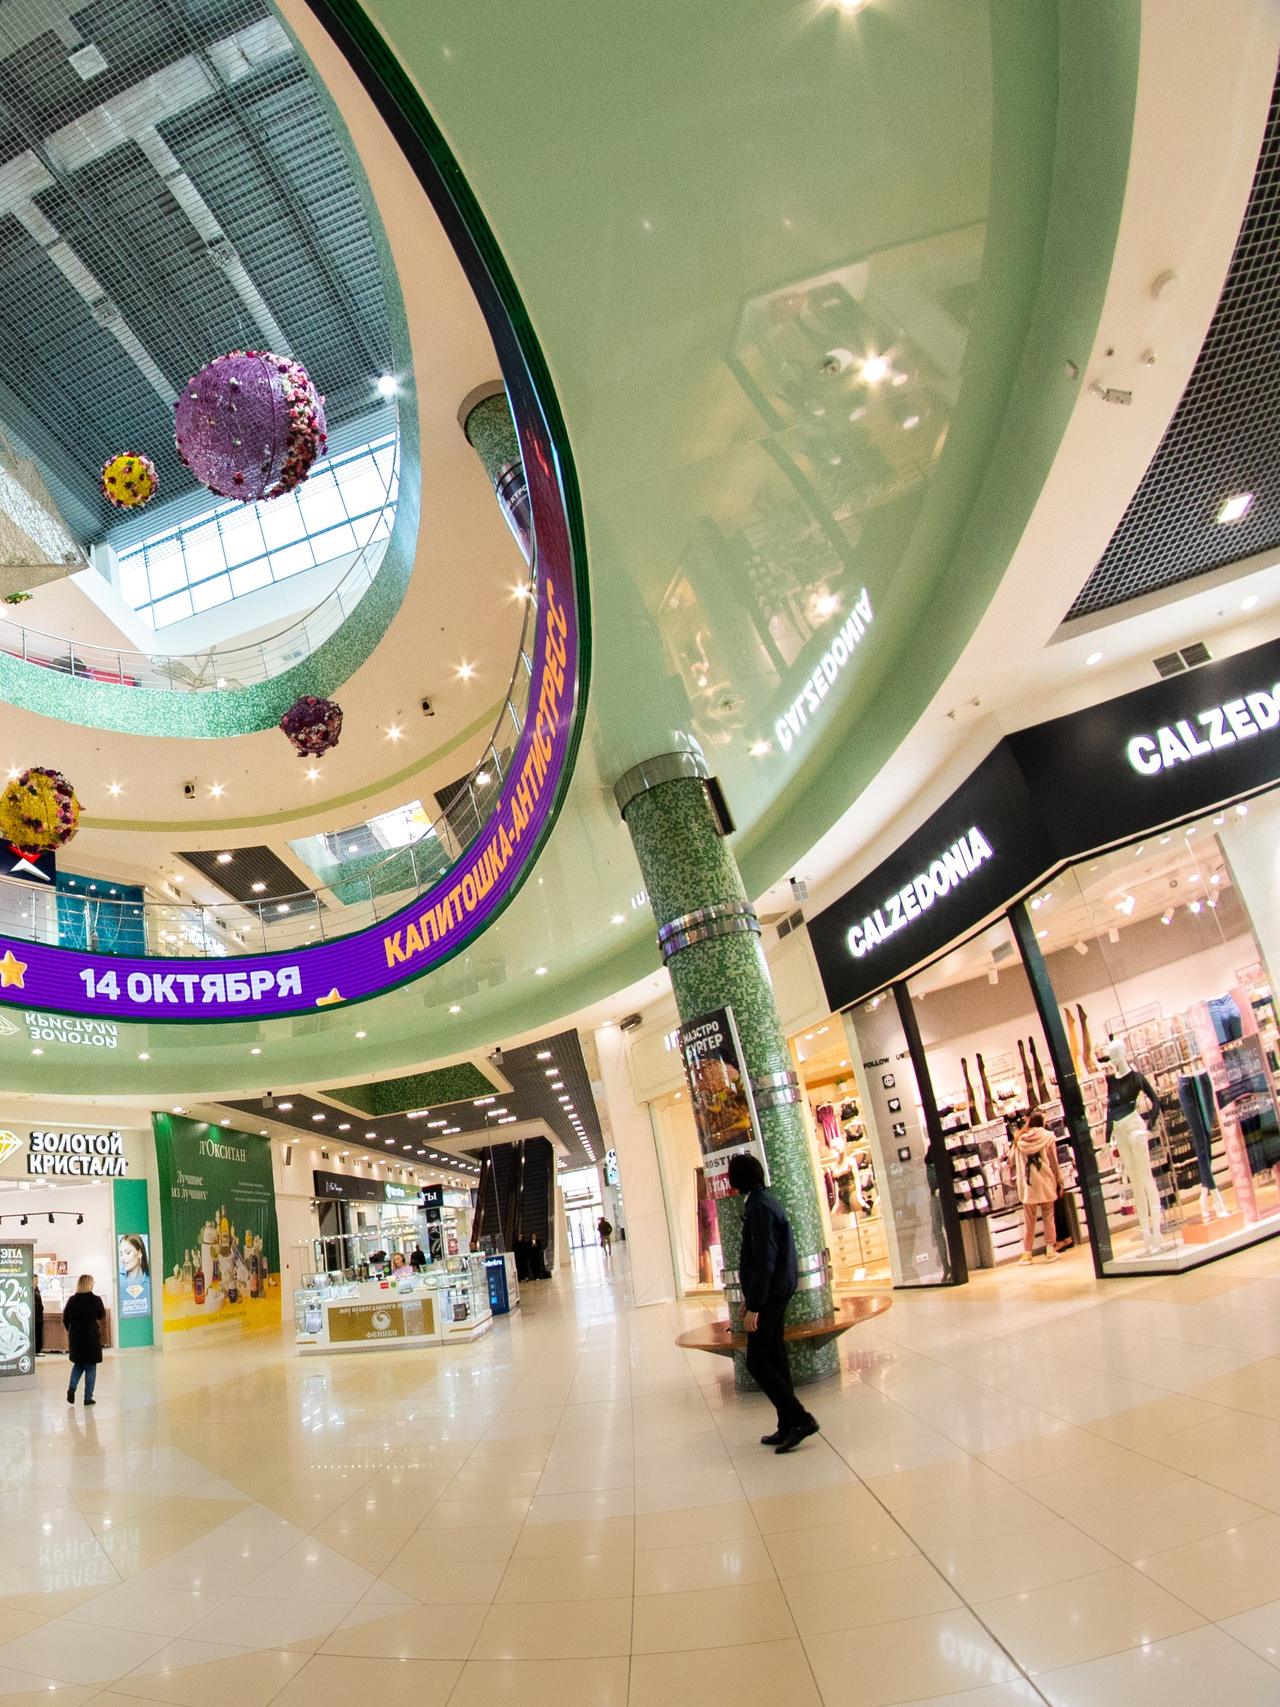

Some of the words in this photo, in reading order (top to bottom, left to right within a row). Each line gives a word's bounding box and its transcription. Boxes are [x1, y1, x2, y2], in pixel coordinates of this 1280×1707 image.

[1126, 682, 1280, 776] CALZED
[384, 577, 569, 968] КАПИТОШКА-АНТИСТРЕСС
[847, 826, 995, 958] CALZEDONIA
[78, 968, 121, 1000] 14
[127, 965, 303, 1004] ОКТЯБРЯ
[683, 1020, 720, 1045] МАЭСТРО
[863, 1056, 890, 1070] FOLLOW
[30, 1130, 124, 1155] ЗОЛОТОЙ
[28, 1153, 126, 1176] КРИСТАЛЛ
[0, 1248, 24, 1259] ЭПЛ
